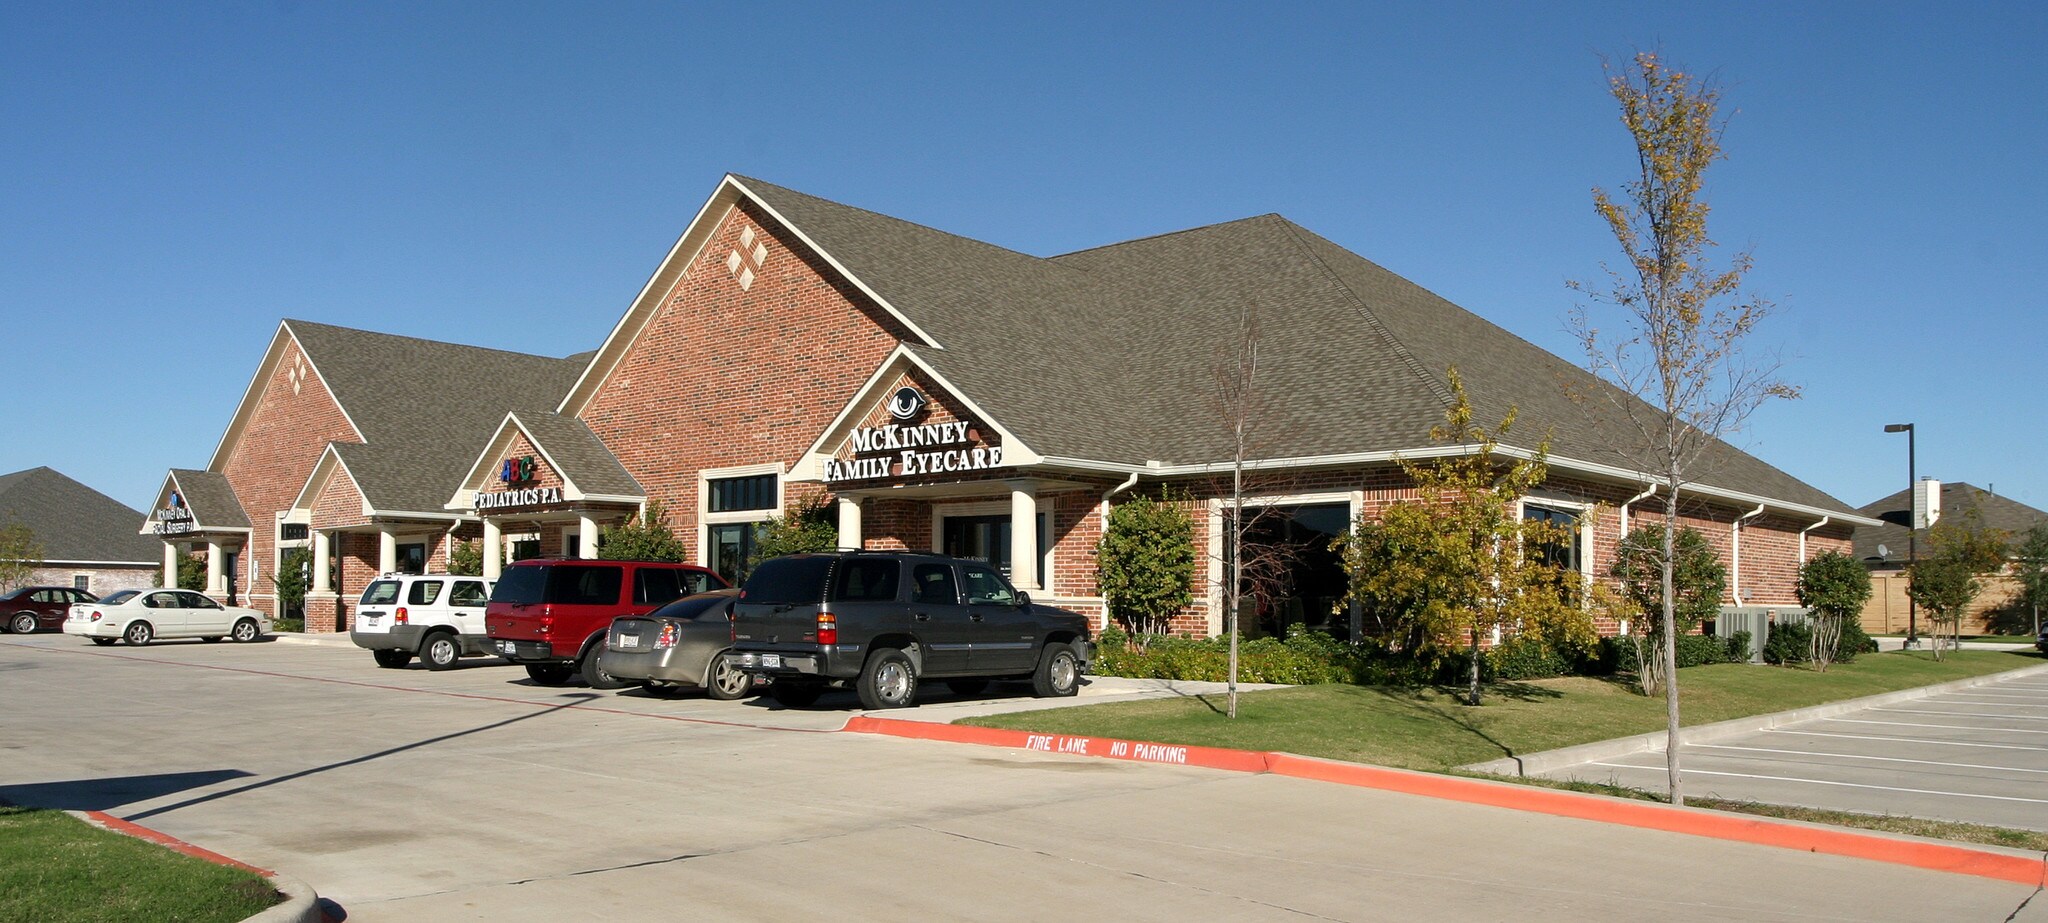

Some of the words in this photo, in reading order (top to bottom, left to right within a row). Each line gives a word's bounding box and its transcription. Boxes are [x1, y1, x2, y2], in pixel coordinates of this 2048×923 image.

[501, 457, 533, 482] ABC
[822, 457, 893, 482] FAMILY
[900, 446, 1002, 476] EYECARE
[472, 489, 538, 508] PEDIATRICS
[541, 488, 562, 504] P.A.
[1025, 735, 1053, 750] FIRE
[1057, 737, 1089, 754] LANE
[1110, 741, 1127, 756] NO
[1133, 743, 1187, 764] PARKING
